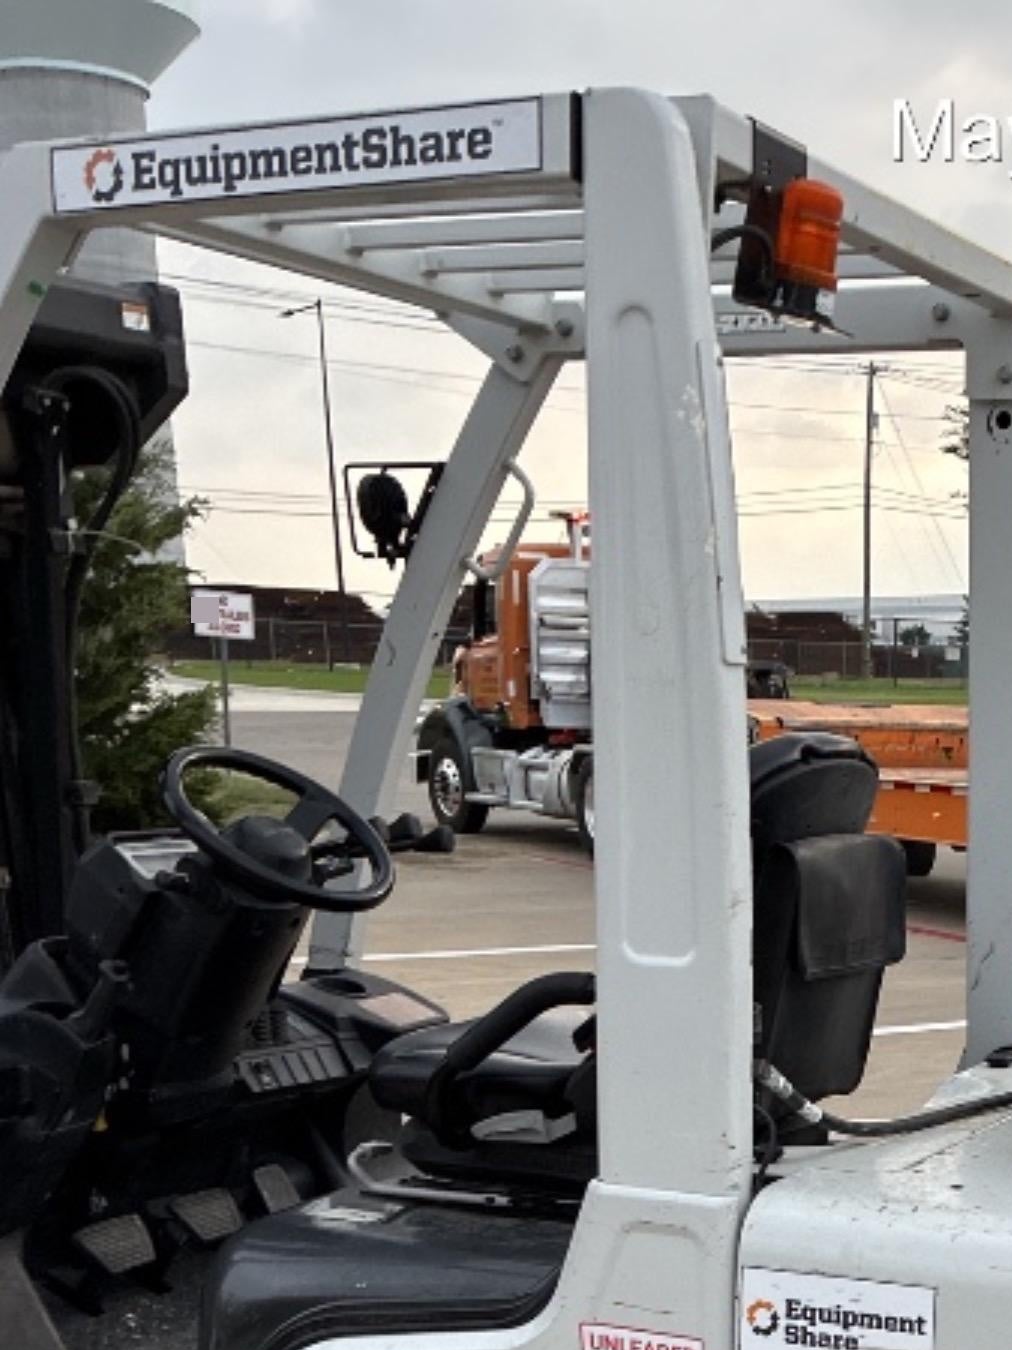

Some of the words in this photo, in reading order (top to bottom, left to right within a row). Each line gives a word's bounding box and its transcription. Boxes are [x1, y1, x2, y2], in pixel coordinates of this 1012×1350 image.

[131, 126, 493, 198] EquipmentShare
[785, 1298, 928, 1335] Equipment
[785, 1324, 859, 1350] Share
